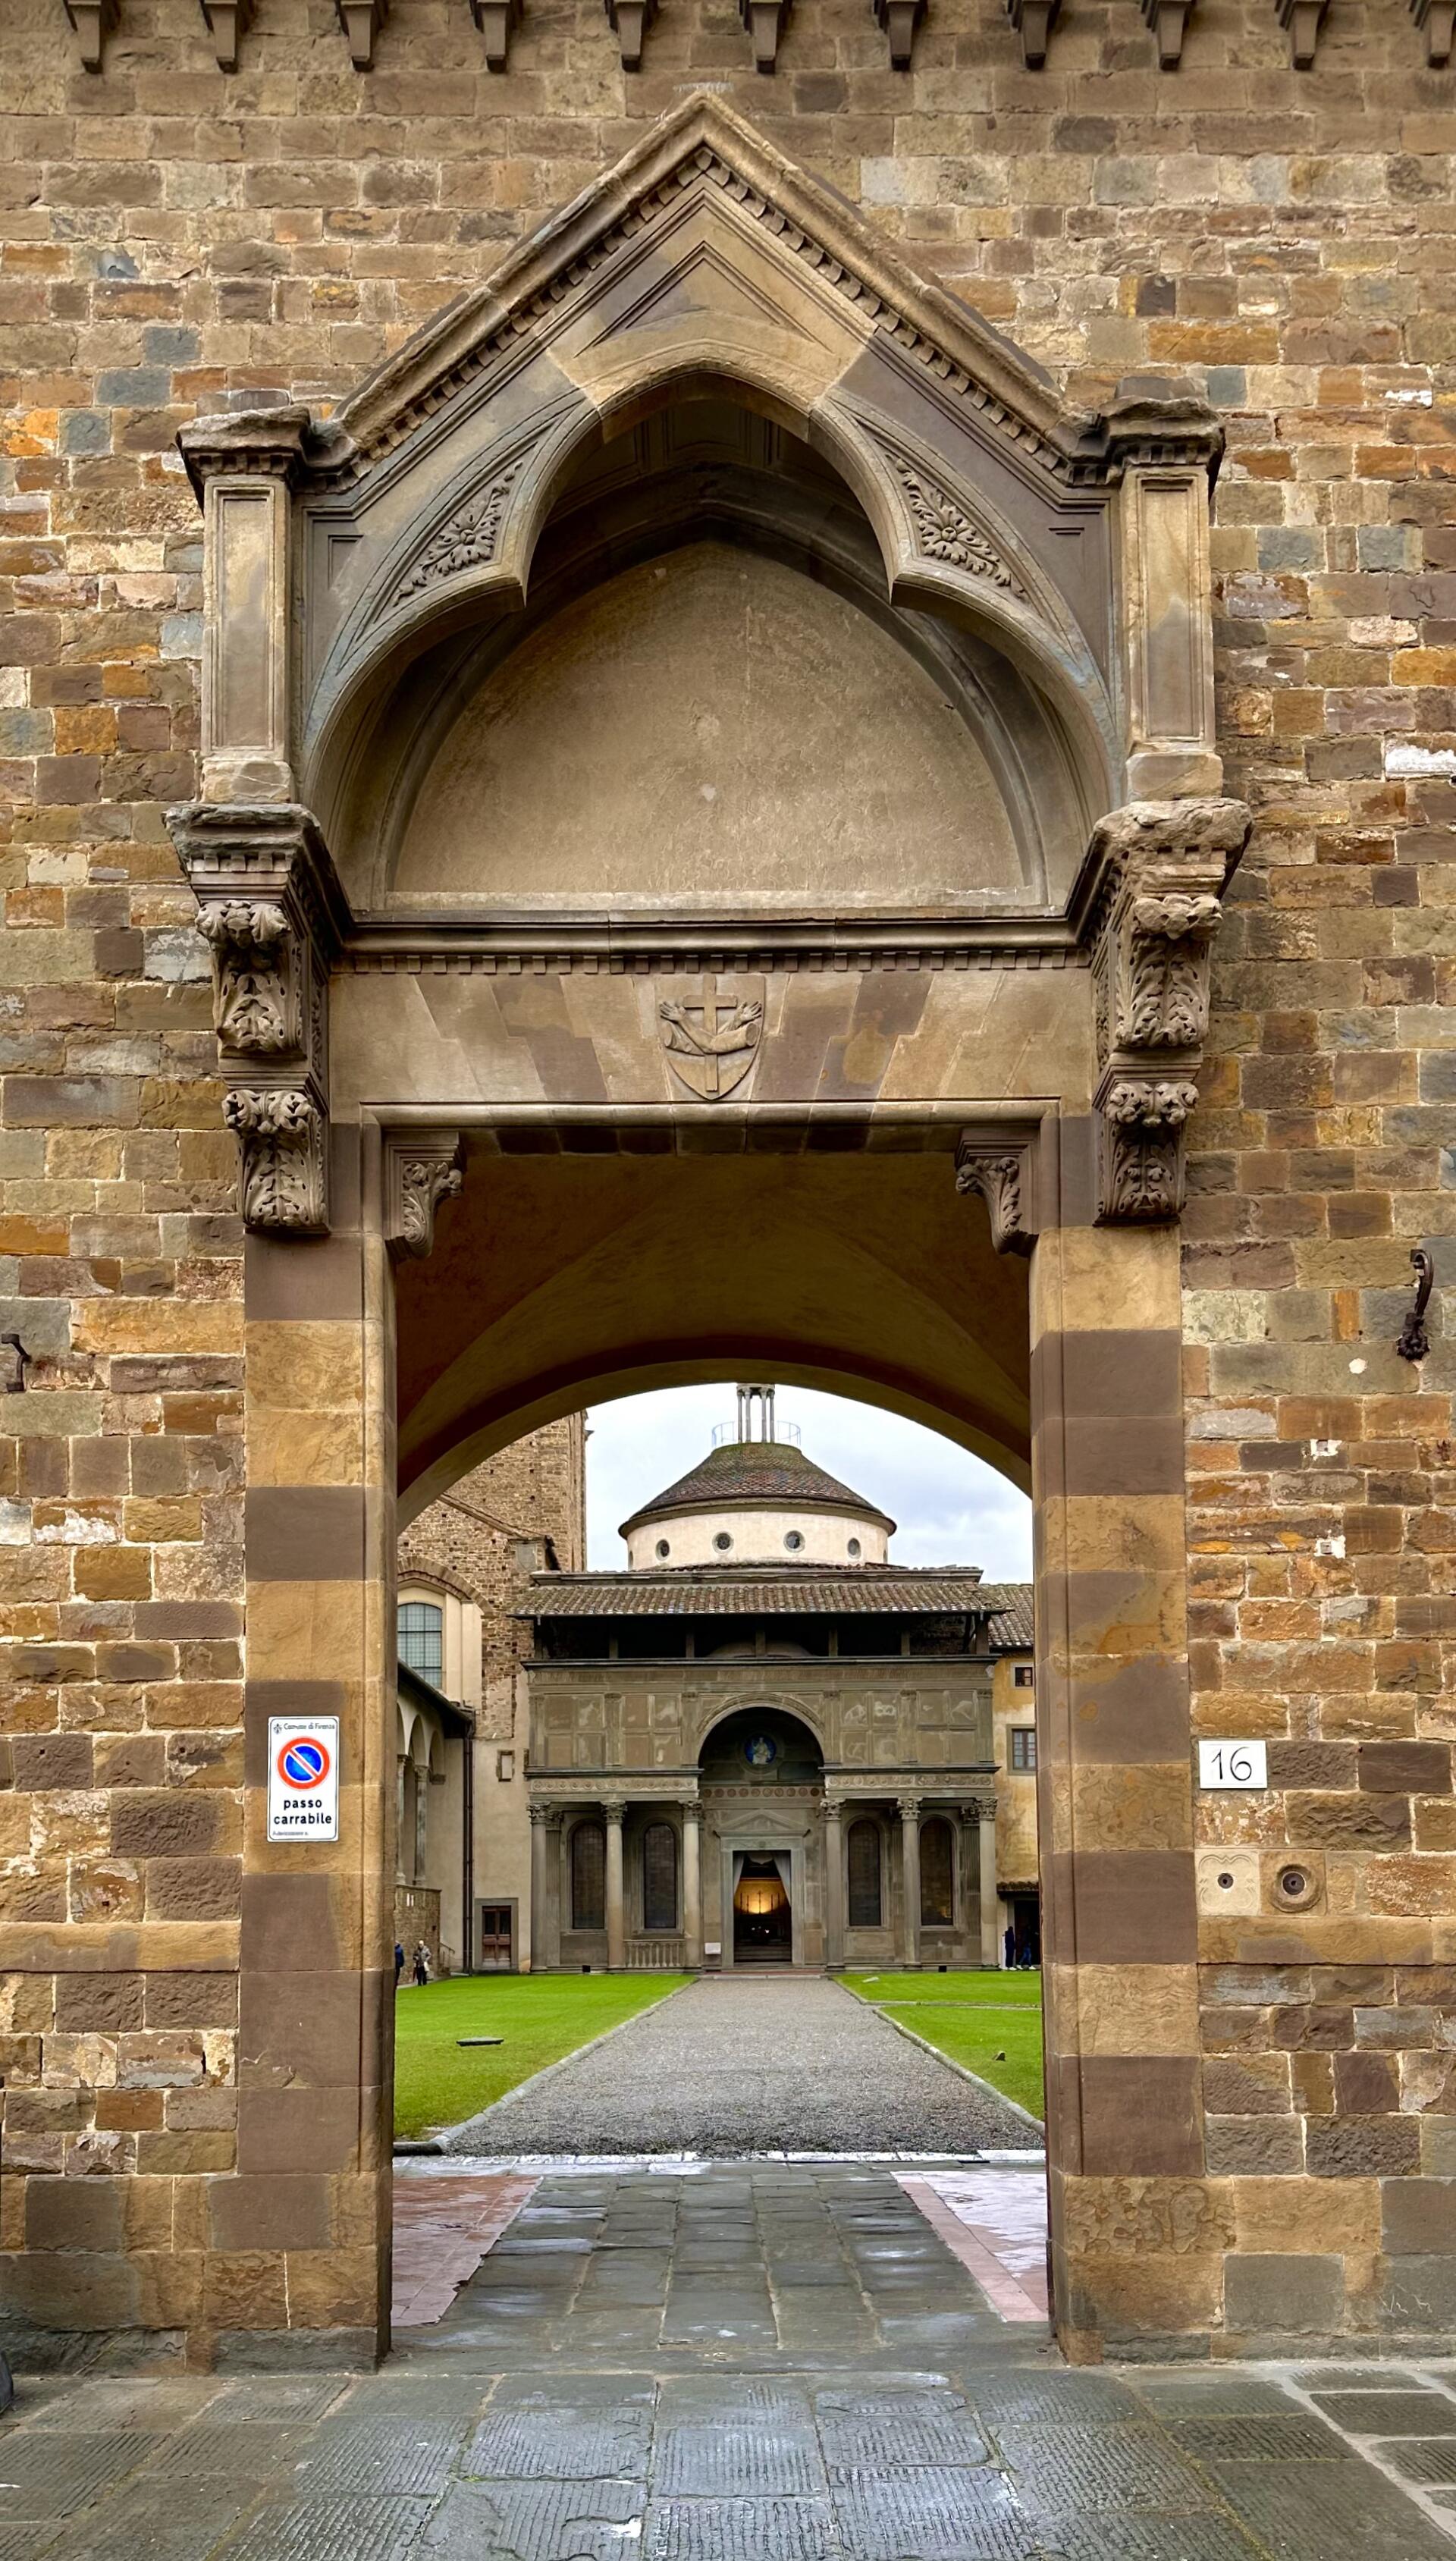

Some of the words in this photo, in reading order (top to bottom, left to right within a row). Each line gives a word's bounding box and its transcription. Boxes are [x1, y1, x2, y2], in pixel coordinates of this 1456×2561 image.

[1211, 1747, 1252, 1781] 16
[284, 1799, 322, 1810] passo
[274, 1812, 332, 1825] carrabile
